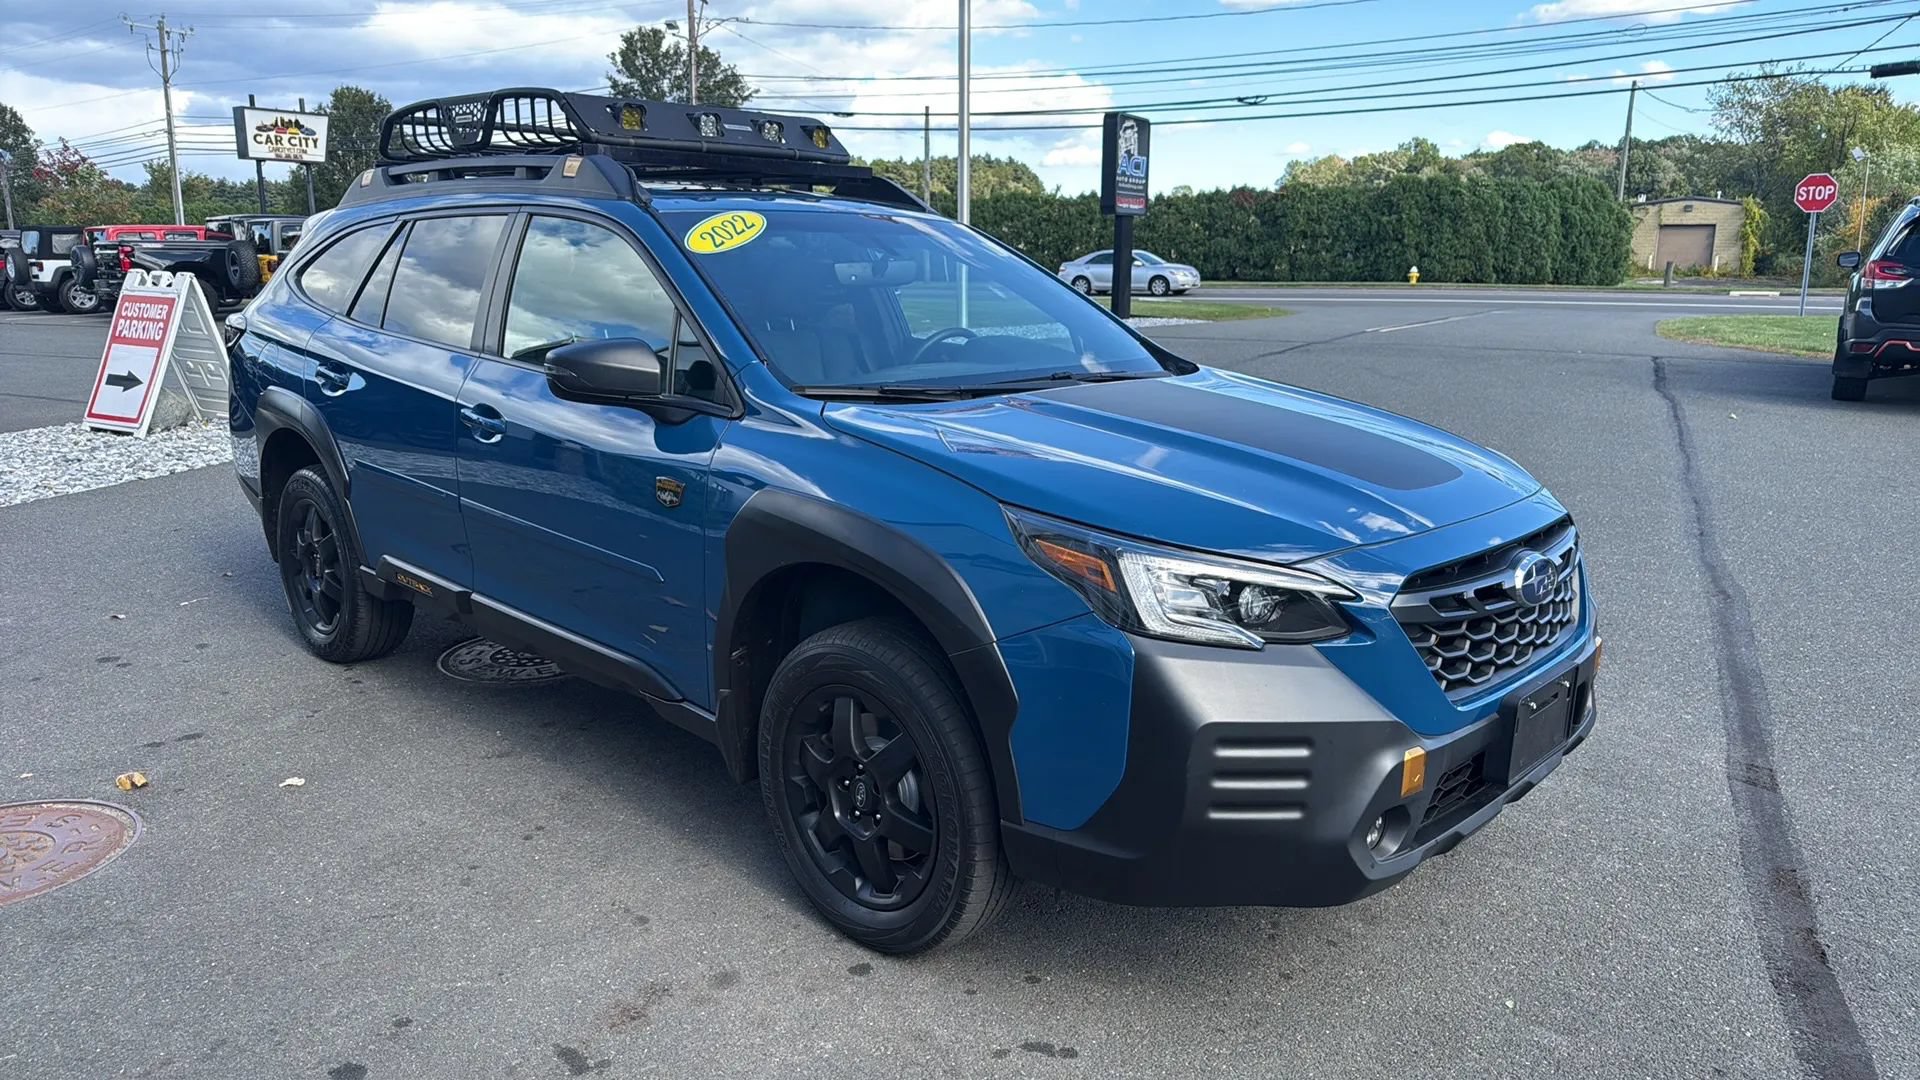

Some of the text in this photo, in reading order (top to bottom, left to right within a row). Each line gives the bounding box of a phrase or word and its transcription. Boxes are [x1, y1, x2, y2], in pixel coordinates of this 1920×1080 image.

[253, 133, 319, 149] CAR CITY
[1119, 152, 1147, 177] ACI
[1797, 185, 1835, 201] STOP
[700, 214, 756, 248] 2022
[121, 301, 169, 320] CUSTOMER
[115, 318, 164, 341] PARKING
